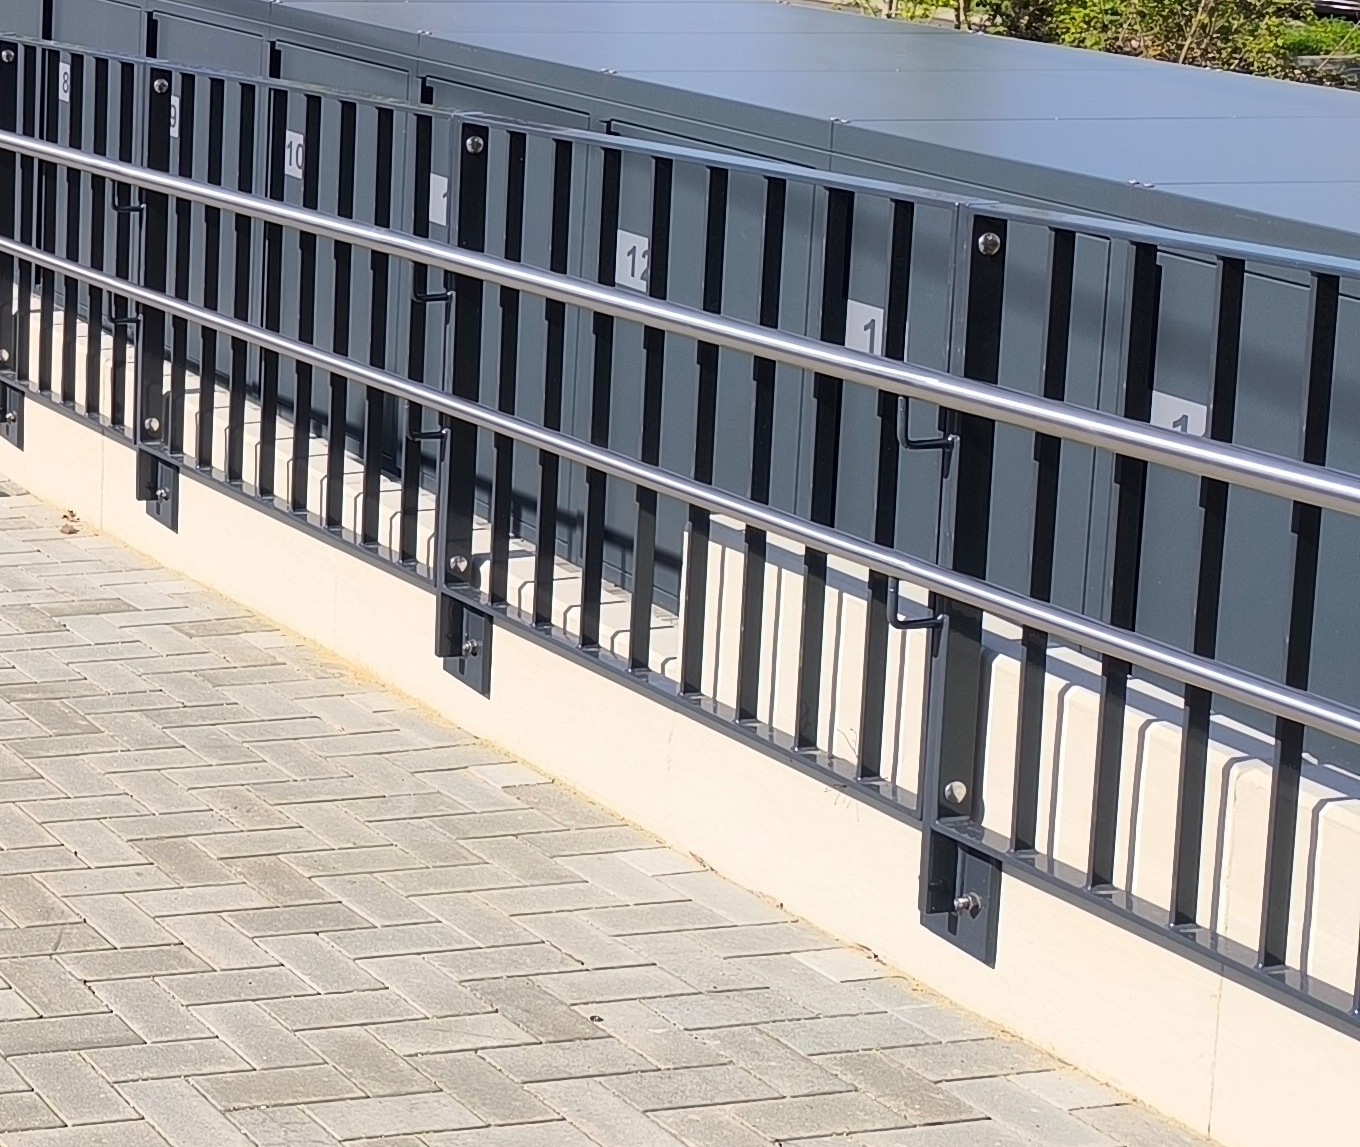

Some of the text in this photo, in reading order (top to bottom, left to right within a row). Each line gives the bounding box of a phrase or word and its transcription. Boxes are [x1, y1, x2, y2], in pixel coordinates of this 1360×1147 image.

[62, 71, 70, 94] 8
[170, 104, 177, 128] 9
[286, 140, 305, 170] 10
